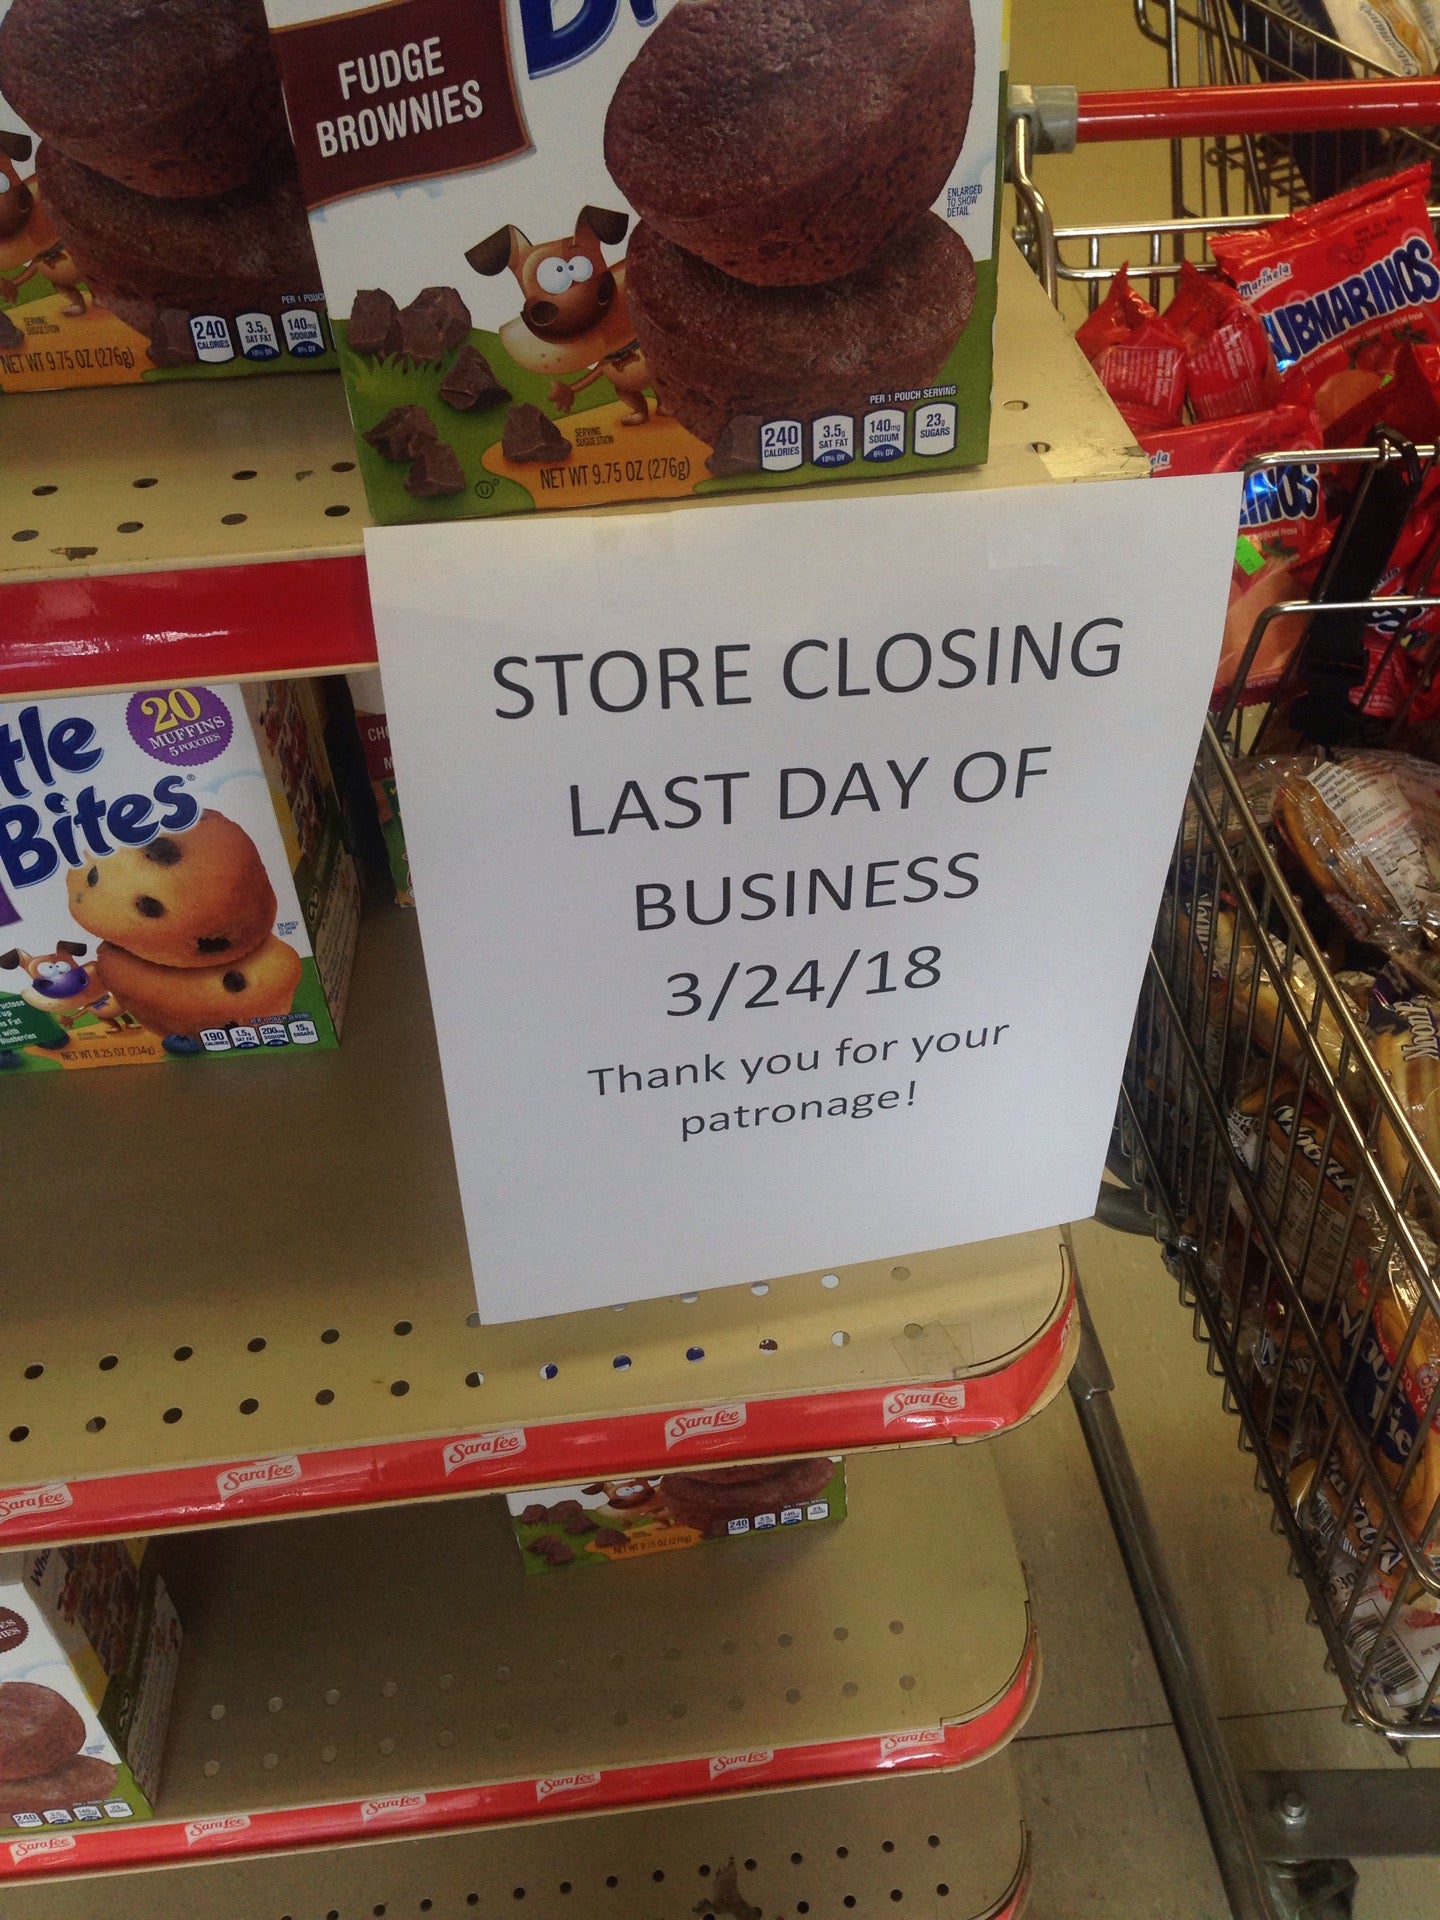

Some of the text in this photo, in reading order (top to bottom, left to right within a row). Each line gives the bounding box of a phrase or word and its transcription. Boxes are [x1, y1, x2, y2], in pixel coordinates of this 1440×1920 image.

[338, 36, 445, 100] FUDGE
[316, 79, 483, 159] BROWNIES
[947, 184, 983, 198] ENLARGED
[947, 195, 977, 207] TO SHOW
[947, 206, 969, 218] DETAIL
[194, 320, 226, 340] 240
[245, 335, 272, 344] SAT FAT
[290, 331, 318, 340] SODIUM
[197, 340, 230, 350] CALORIES
[1, 346, 135, 374] NET WT 9.75 OZ (276g)
[869, 385, 957, 404] PER 1 POUCH SERVING
[575, 427, 601, 437] SERVING
[575, 436, 614, 447] SUGGESTION
[764, 426, 798, 447] 240
[869, 433, 899, 444] SODIUM
[920, 427, 950, 438] SUGARS
[764, 447, 800, 458] CALORIES
[818, 438, 849, 449] SAT FAT
[540, 456, 690, 490] NET WT 9.75 OZ (276g)
[494, 618, 1123, 719] STORE CLOSING
[141, 689, 201, 732] 20
[148, 716, 225, 749] MUFFINS
[169, 733, 221, 756] 5 POUCHES
[570, 746, 1051, 836] LAST DAY OF
[0, 775, 200, 888] Bites
[636, 853, 979, 931] BUSINESS
[667, 946, 941, 1021] 3/24/18
[203, 1032, 225, 1042] 190
[587, 1025, 1009, 1095] Thank you for your
[683, 1081, 915, 1142] patronage!
[888, 1392, 958, 1414] Sara Lee
[670, 1410, 739, 1437] Sara Lee
[449, 1436, 520, 1464] Sara Lee
[223, 1462, 294, 1490] Sara Lee
[0, 1491, 65, 1517] Sara Lee
[730, 1519, 748, 1530] 240
[713, 1751, 767, 1771] Sara Lee
[541, 1773, 595, 1793] Sara Lee
[190, 1817, 244, 1836] Sara Lee
